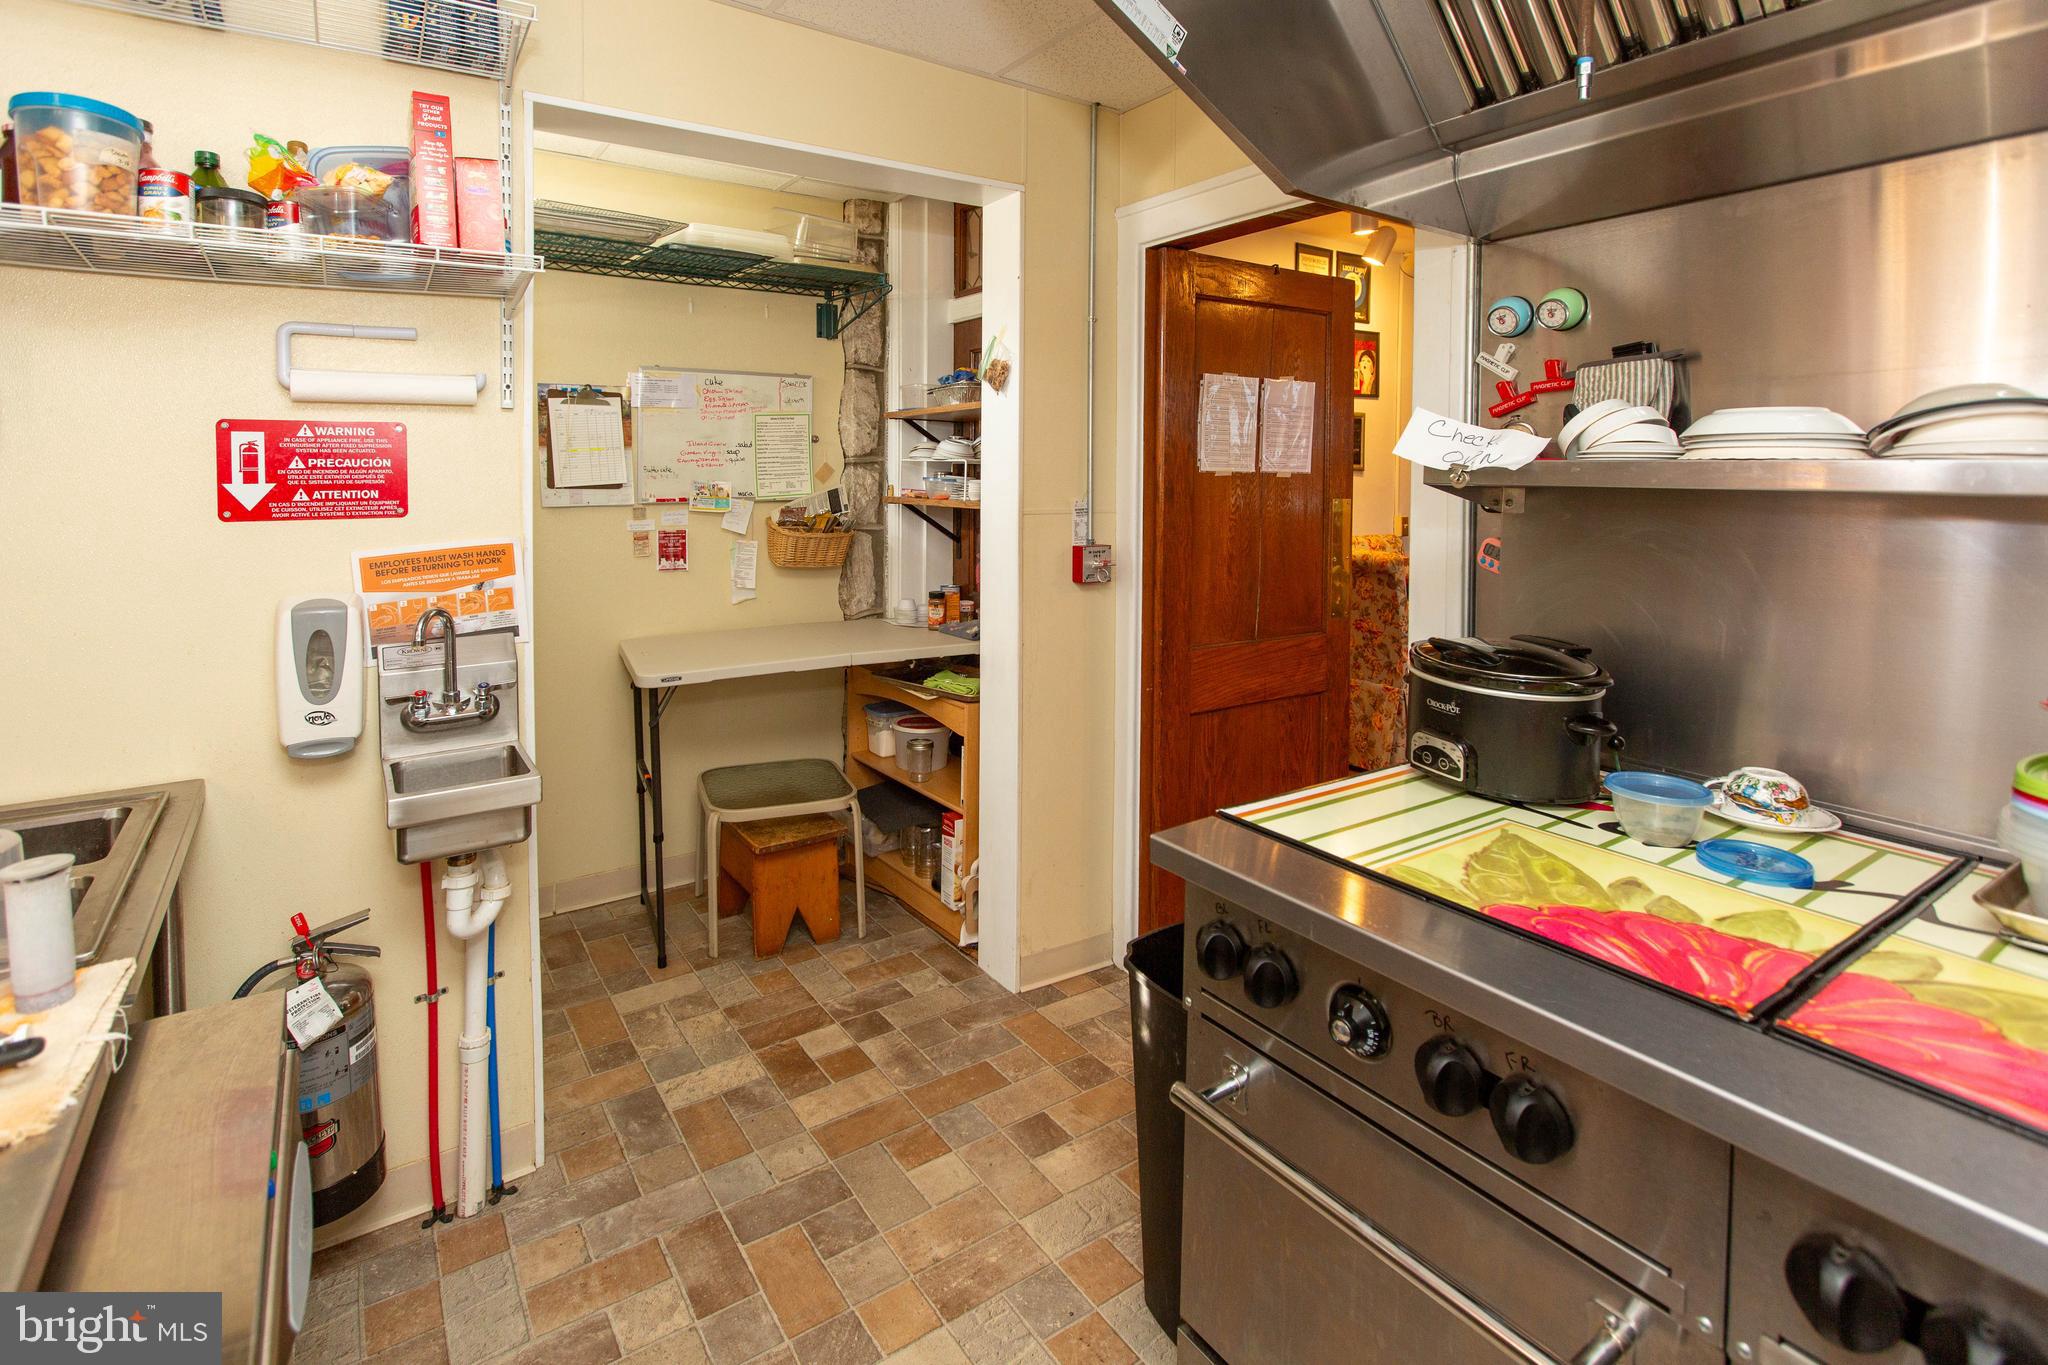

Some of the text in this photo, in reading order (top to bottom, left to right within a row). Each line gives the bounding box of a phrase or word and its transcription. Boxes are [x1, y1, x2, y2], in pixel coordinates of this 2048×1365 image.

[417, 121, 448, 130] PRODUCTS
[1480, 355, 1501, 370] MAGNETIC
[1492, 400, 1515, 413] MAGNETIC
[315, 427, 375, 436] WARNING
[1428, 420, 1502, 447] Check
[308, 457, 391, 467] PRECAUCIÓN
[1442, 450, 1503, 465] OVN
[312, 490, 379, 500] ATTENTION
[369, 558, 421, 569] EMPLOYEES
[424, 555, 446, 563] MUST
[476, 549, 506, 558] HANDS
[376, 567, 409, 577] BEFORE
[412, 561, 460, 573] RETURNING
[476, 557, 502, 565] WORK
[1258, 920, 1271, 933] FL
[291, 996, 321, 1016] PROTECTION
[1425, 1010, 1456, 1032] BR
[1505, 1052, 1536, 1072] FR
